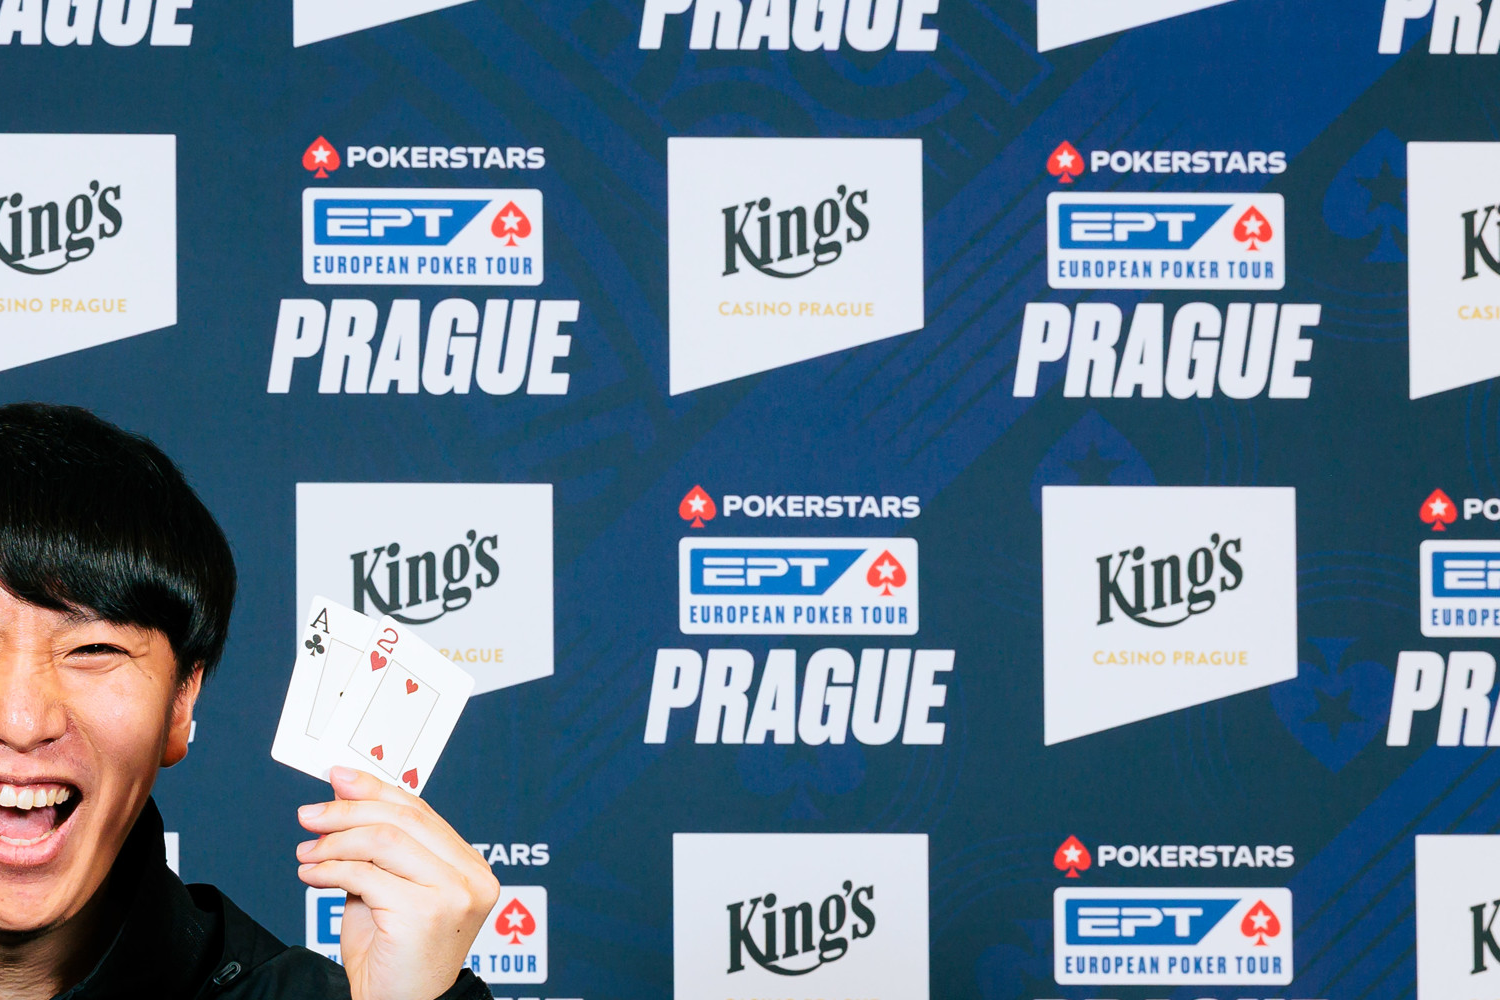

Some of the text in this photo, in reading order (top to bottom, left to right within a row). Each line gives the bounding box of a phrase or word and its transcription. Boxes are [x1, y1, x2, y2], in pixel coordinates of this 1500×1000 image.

[348, 147, 545, 168] POKERSTARS
[1091, 151, 1286, 173] POKERSTARS
[327, 208, 452, 236] EPT
[722, 185, 869, 278] King's
[1071, 213, 1195, 241] EPT
[314, 256, 532, 275] EUROPEAN POKER TOUR
[1059, 260, 1273, 278] EUROPEAN POKER TOUR
[51, 298, 126, 312] PRAGUE
[719, 302, 873, 316] CASINO PRAGUE
[267, 299, 579, 395] PRAGUE
[1013, 302, 1321, 399] PRAGUE
[724, 496, 920, 518] POKERSTARS
[351, 530, 500, 625] King's
[703, 558, 828, 586] EPT
[1097, 533, 1242, 627] King's
[310, 607, 330, 634] A
[690, 606, 907, 624] EUROPEAN POKER TOUR
[377, 628, 399, 654] 2
[1093, 651, 1247, 665] CASINO PRAGUE
[644, 648, 955, 745] PRAGUE
[1098, 846, 1294, 867] POKERSTARS
[727, 881, 875, 976] King's
[1078, 908, 1202, 936] EPT
[489, 955, 537, 973] TOUR
[1065, 956, 1281, 974] EUROPEAN POKER TOUR
